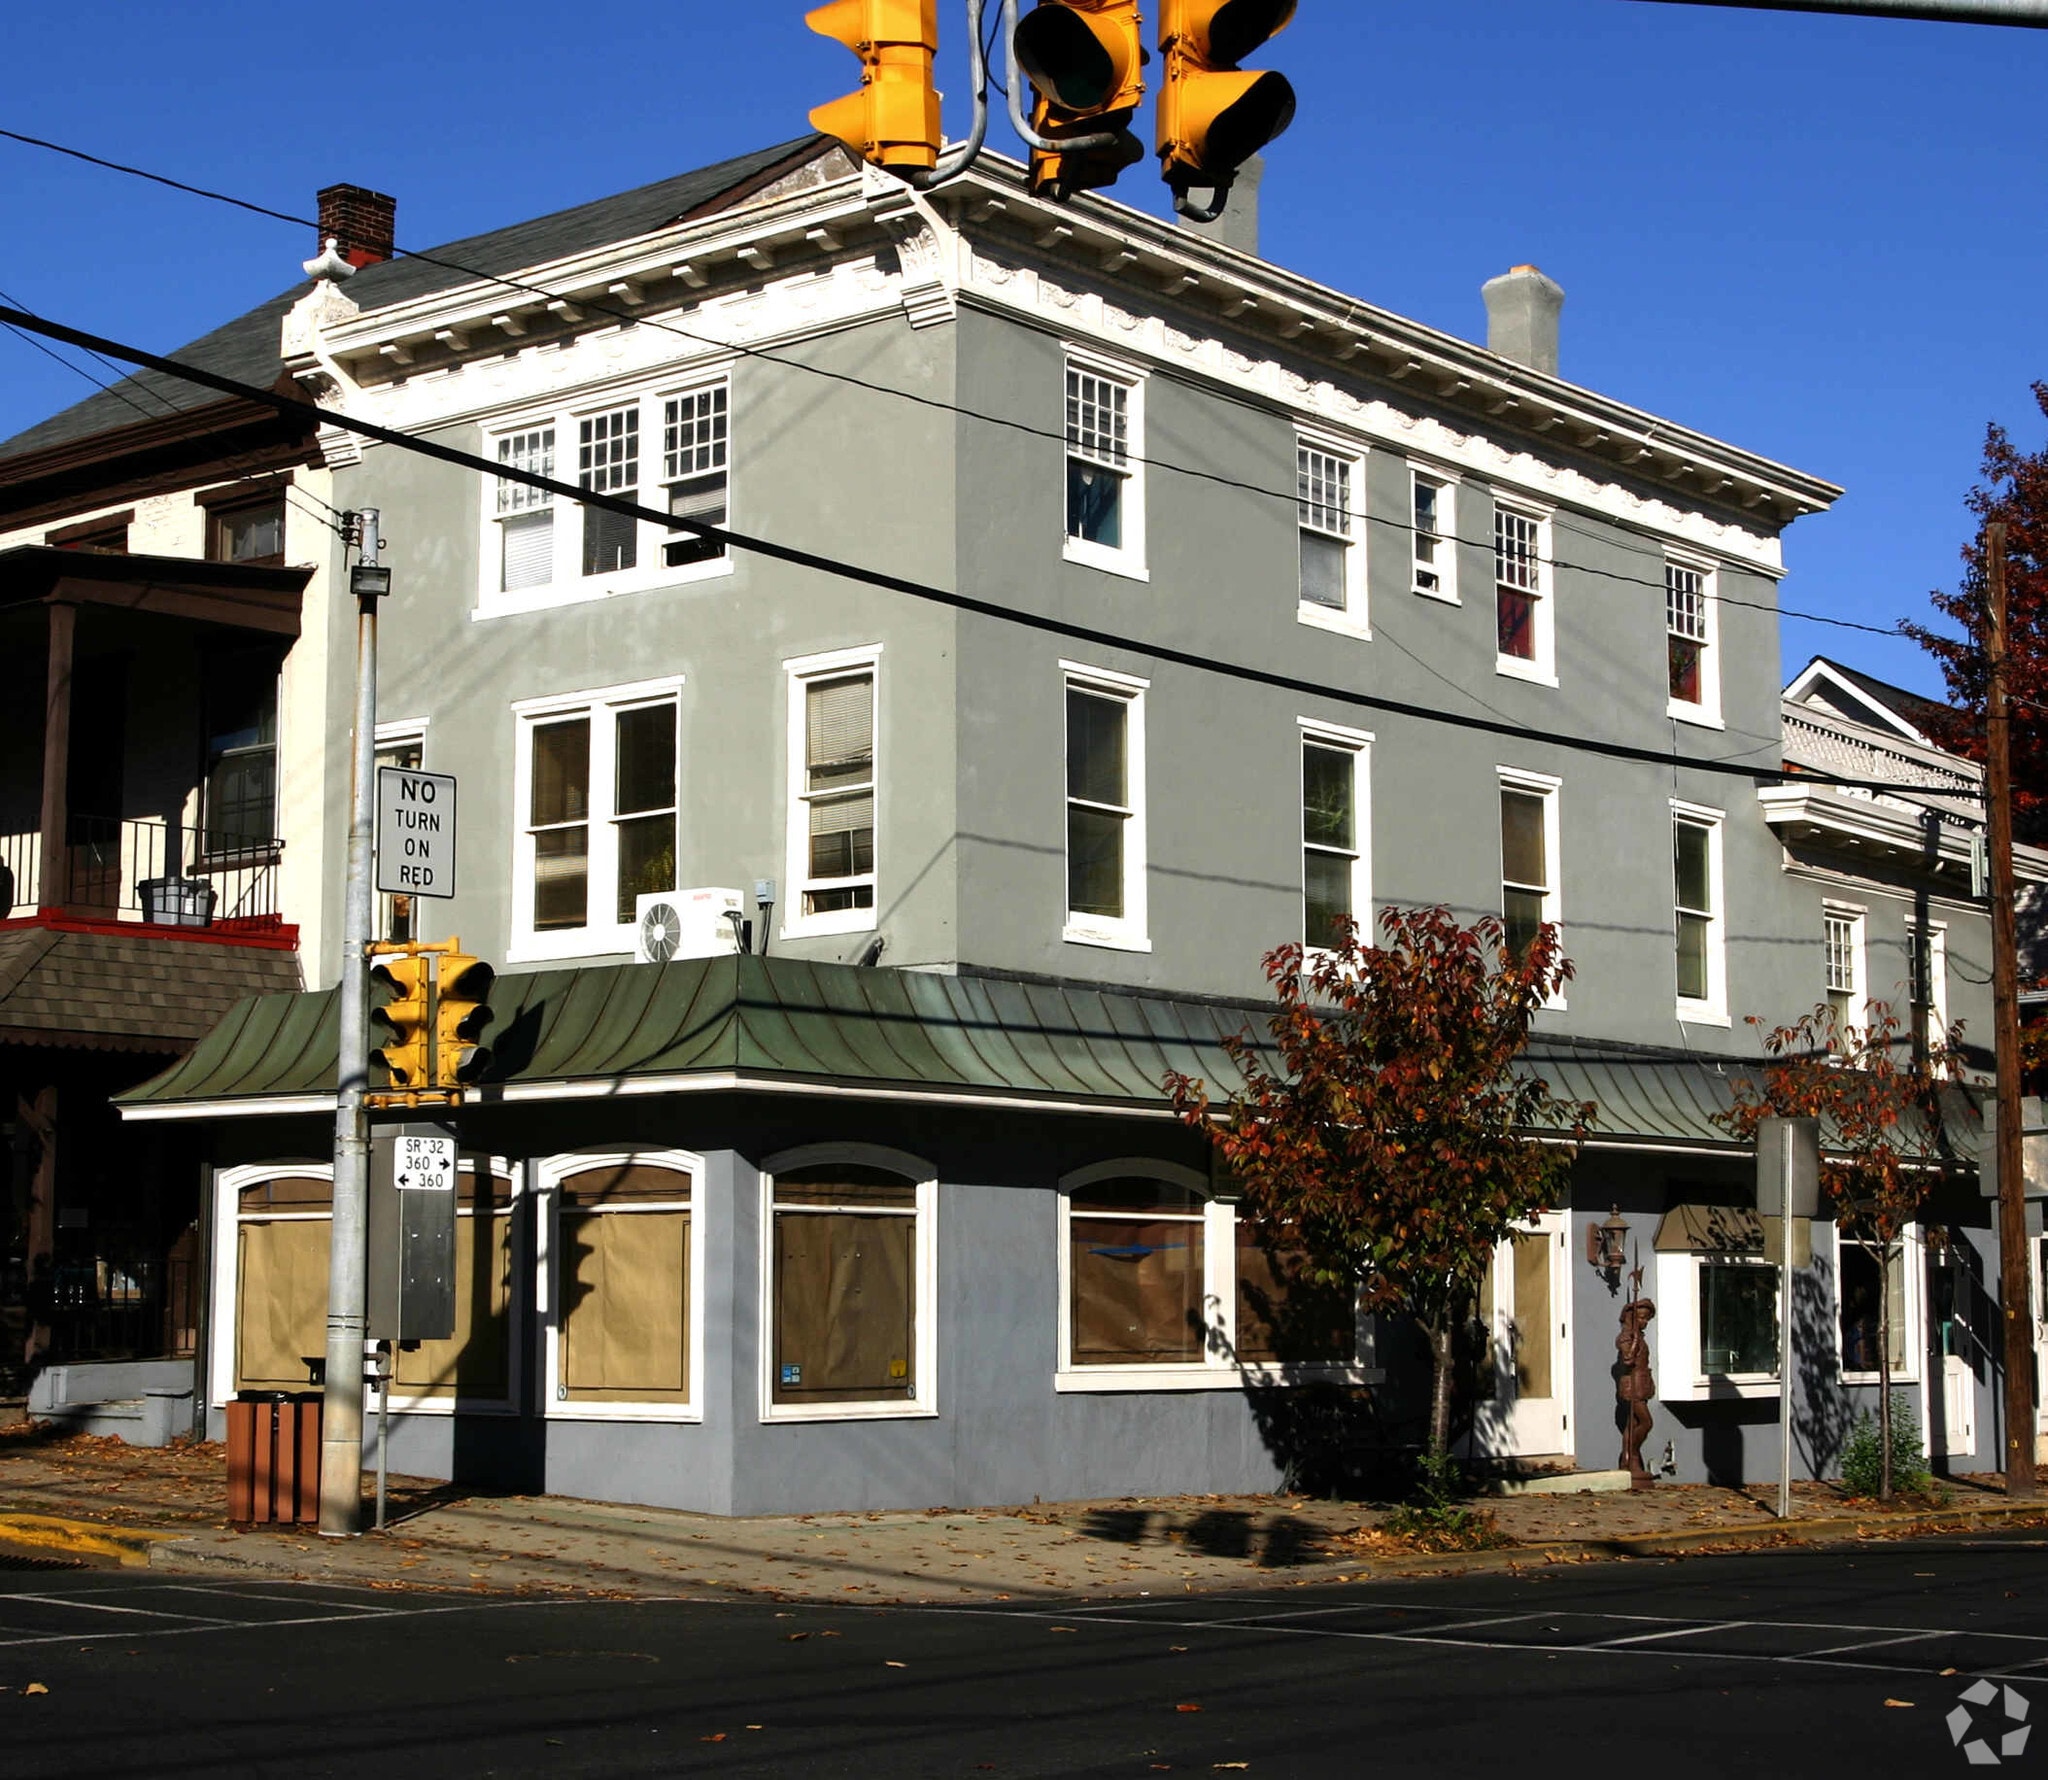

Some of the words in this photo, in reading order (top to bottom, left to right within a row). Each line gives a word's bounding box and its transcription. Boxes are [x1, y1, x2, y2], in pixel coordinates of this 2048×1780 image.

[401, 777, 436, 804] NO
[395, 809, 440, 832] TURN
[404, 838, 429, 858] ON
[400, 865, 434, 886] RED
[406, 1138, 421, 1153] SR
[428, 1140, 444, 1154] 32
[405, 1155, 430, 1170] 360
[418, 1173, 443, 1187] 360
